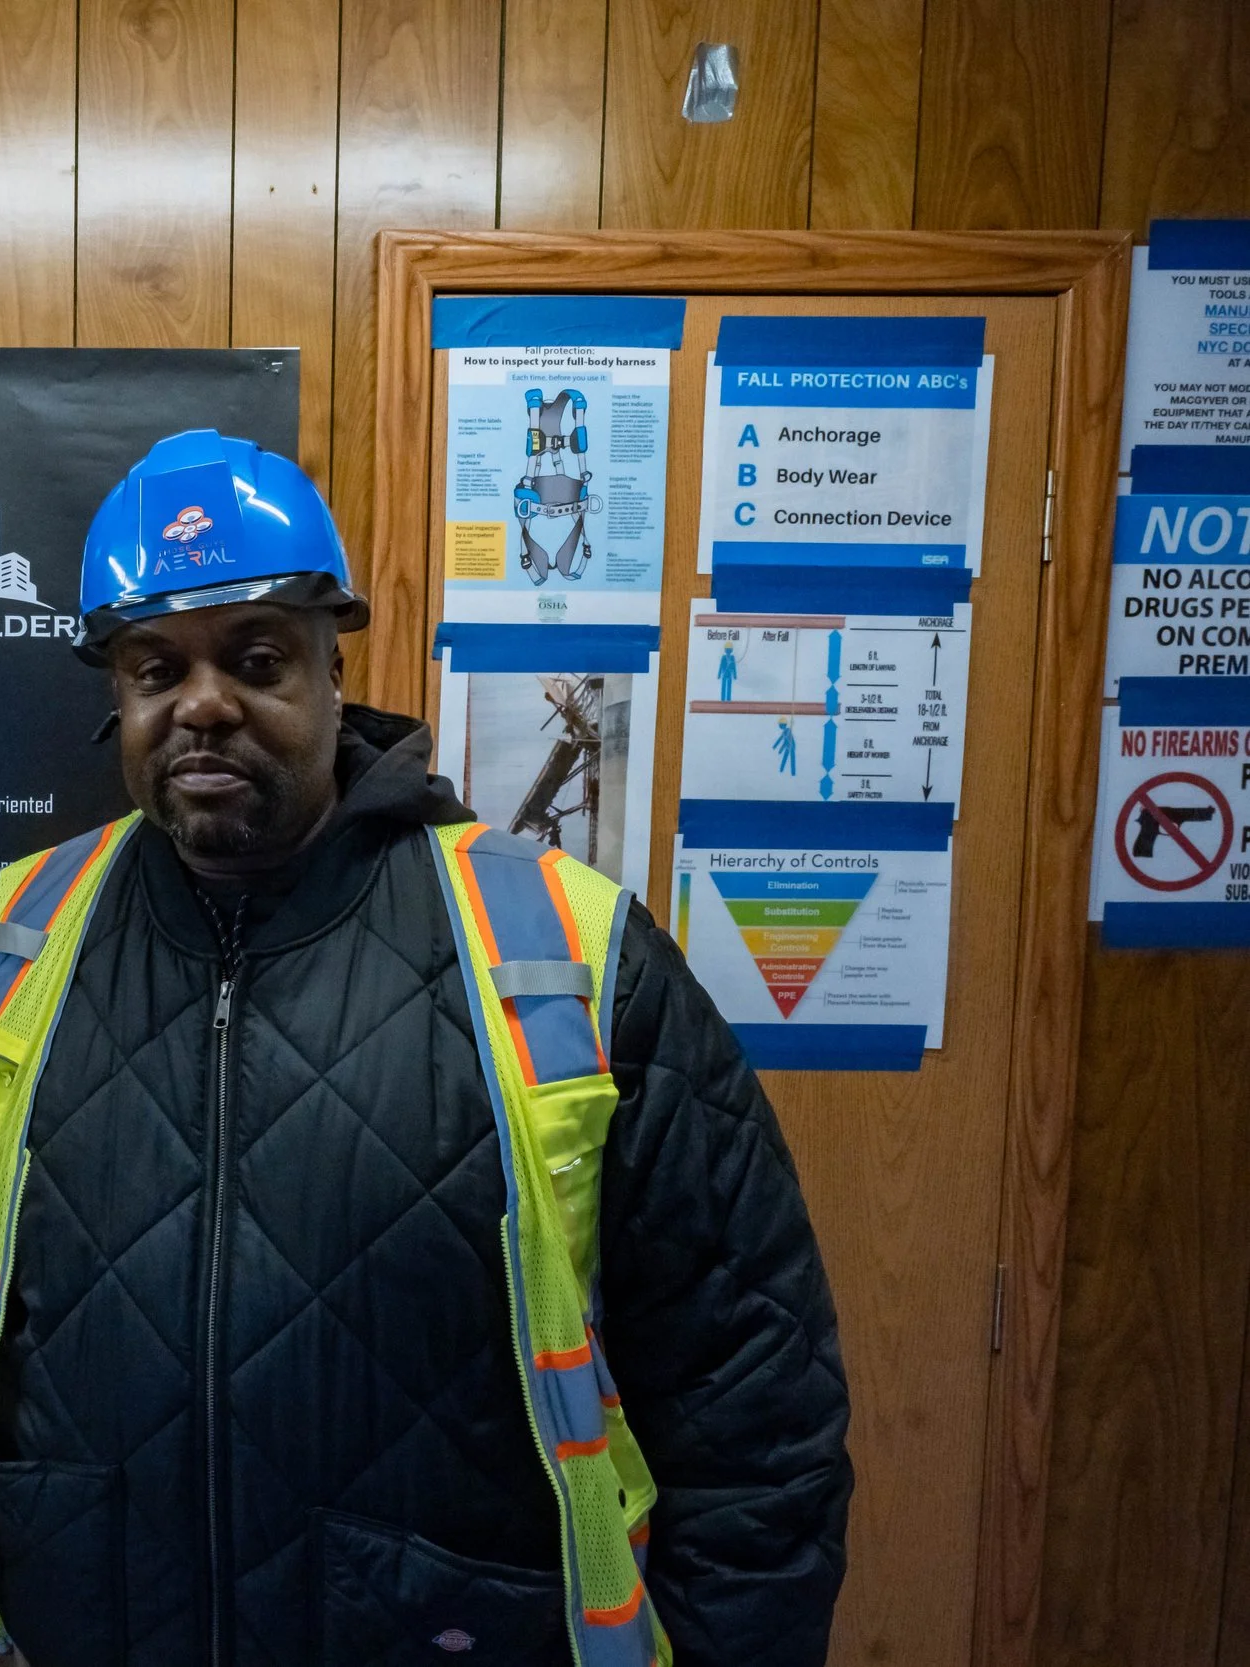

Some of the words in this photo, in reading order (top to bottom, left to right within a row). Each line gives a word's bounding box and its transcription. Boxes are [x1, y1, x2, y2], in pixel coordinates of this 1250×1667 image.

[1172, 276, 1195, 285] YOU
[1199, 276, 1230, 285] MUST
[1209, 290, 1245, 299] TOOLS
[525, 346, 542, 355] Fall
[544, 347, 595, 359] protection:
[1198, 341, 1228, 354] NYC
[464, 357, 486, 365] How
[502, 357, 540, 368] inspect
[542, 358, 564, 368] your
[567, 357, 613, 368] full-body
[616, 357, 656, 366] harness
[1228, 359, 1241, 368] AT
[737, 372, 783, 388] FALL
[791, 373, 910, 388] PROTECTION
[917, 374, 968, 389] ABC's
[1154, 384, 1176, 392] YOU
[1180, 384, 1201, 392] MAY
[1204, 384, 1225, 392] NOT
[1170, 396, 1228, 405] MACGYVER
[1232, 397, 1246, 405] OR
[1153, 408, 1215, 417] EQUIPMENT
[1218, 409, 1243, 418] THAT
[1144, 421, 1164, 429] THE
[1168, 421, 1188, 430] DAY
[1190, 421, 1231, 430] IT/THEY
[737, 424, 760, 448] A
[778, 426, 881, 447] Anchorage
[738, 463, 757, 486] B
[777, 468, 824, 488] Body
[829, 469, 877, 485] Wear
[734, 502, 756, 526] C
[774, 509, 882, 526] Connection
[887, 510, 951, 526] Device
[1143, 568, 1182, 589] NO
[1124, 597, 1214, 618] DRUGS
[918, 618, 954, 627] ANCHORAGE
[707, 629, 727, 640] Before
[728, 630, 740, 640] Fall
[762, 631, 776, 641] After
[778, 631, 789, 641] Fall
[1156, 626, 1195, 646] ON
[925, 690, 942, 700] TOTAL
[918, 704, 940, 716] 18-1/2
[923, 722, 939, 731] FROM
[912, 736, 948, 746] ANCHORAGE
[1121, 730, 1146, 757] NO
[1152, 730, 1239, 757] FIREARMS
[710, 853, 785, 871] Hierarchy
[790, 854, 806, 868] of
[812, 854, 879, 868] Controls
[768, 881, 819, 890] Elimination
[764, 907, 820, 916] Substitution
[764, 932, 818, 942] Engineering
